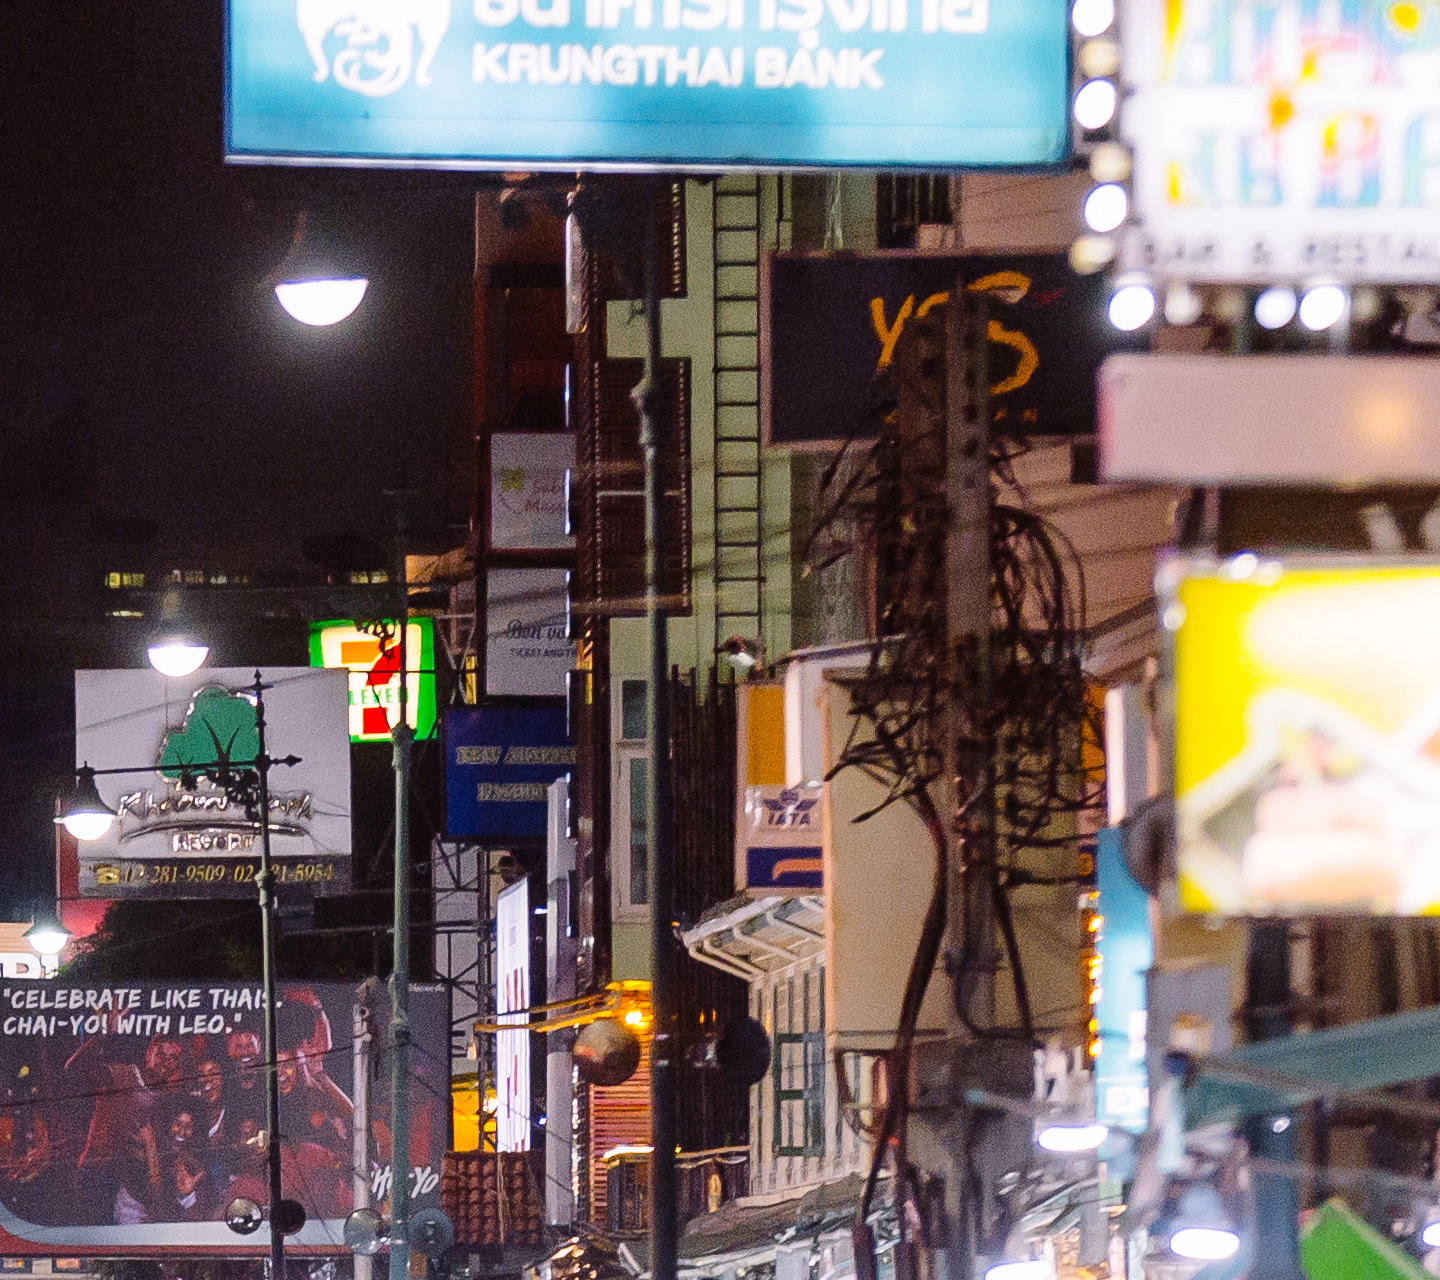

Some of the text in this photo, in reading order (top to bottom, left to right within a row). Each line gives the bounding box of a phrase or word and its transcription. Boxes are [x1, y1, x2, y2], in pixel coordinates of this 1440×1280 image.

[472, 44, 886, 90] KRUNGTHAI BANK
[3, 988, 142, 1011] "CELEBRATE
[150, 989, 202, 1009] LIKE
[2, 1014, 243, 1036] CHAI-YO! WITH LEO."
